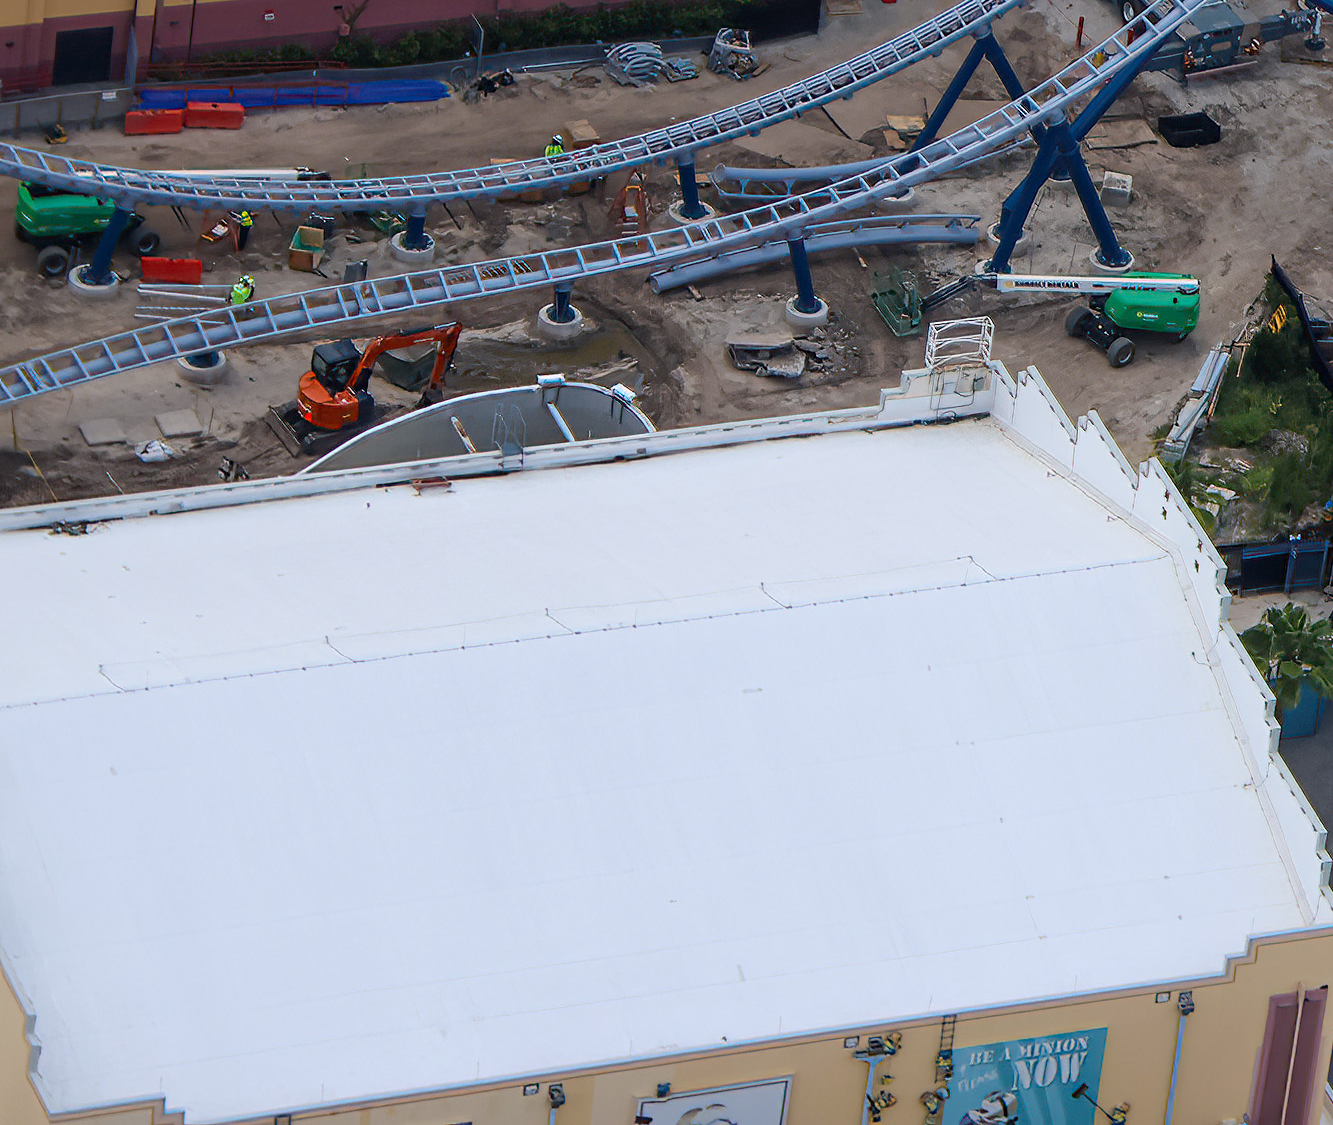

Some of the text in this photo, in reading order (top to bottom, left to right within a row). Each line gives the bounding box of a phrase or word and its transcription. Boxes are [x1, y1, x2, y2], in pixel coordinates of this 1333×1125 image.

[969, 1036, 1090, 1066] BE A MINION
[1011, 1050, 1089, 1092] NOW
